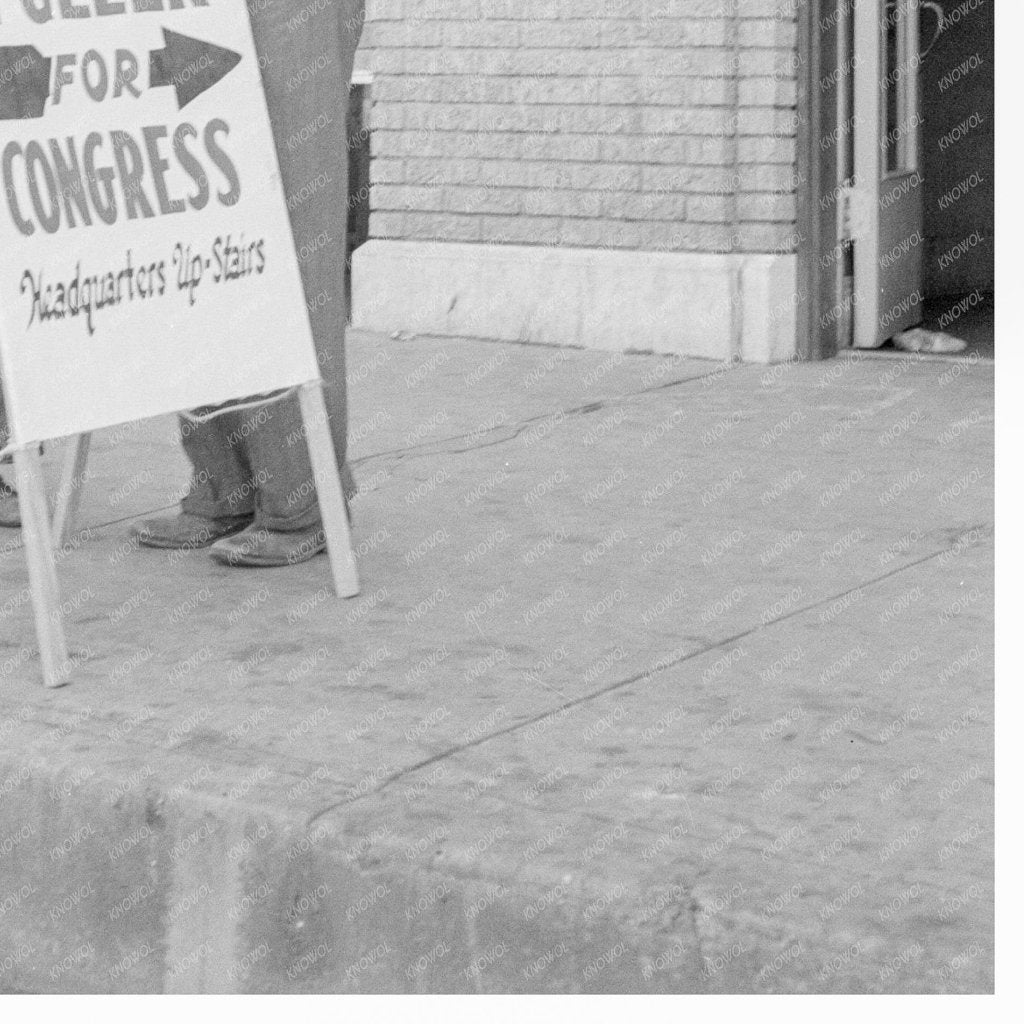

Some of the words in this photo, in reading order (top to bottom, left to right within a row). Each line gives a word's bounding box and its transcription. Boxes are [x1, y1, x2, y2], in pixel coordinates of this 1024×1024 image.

[51, 48, 142, 105] FOR
[1, 118, 241, 237] CONGRESS
[20, 248, 166, 336] Headquarters
